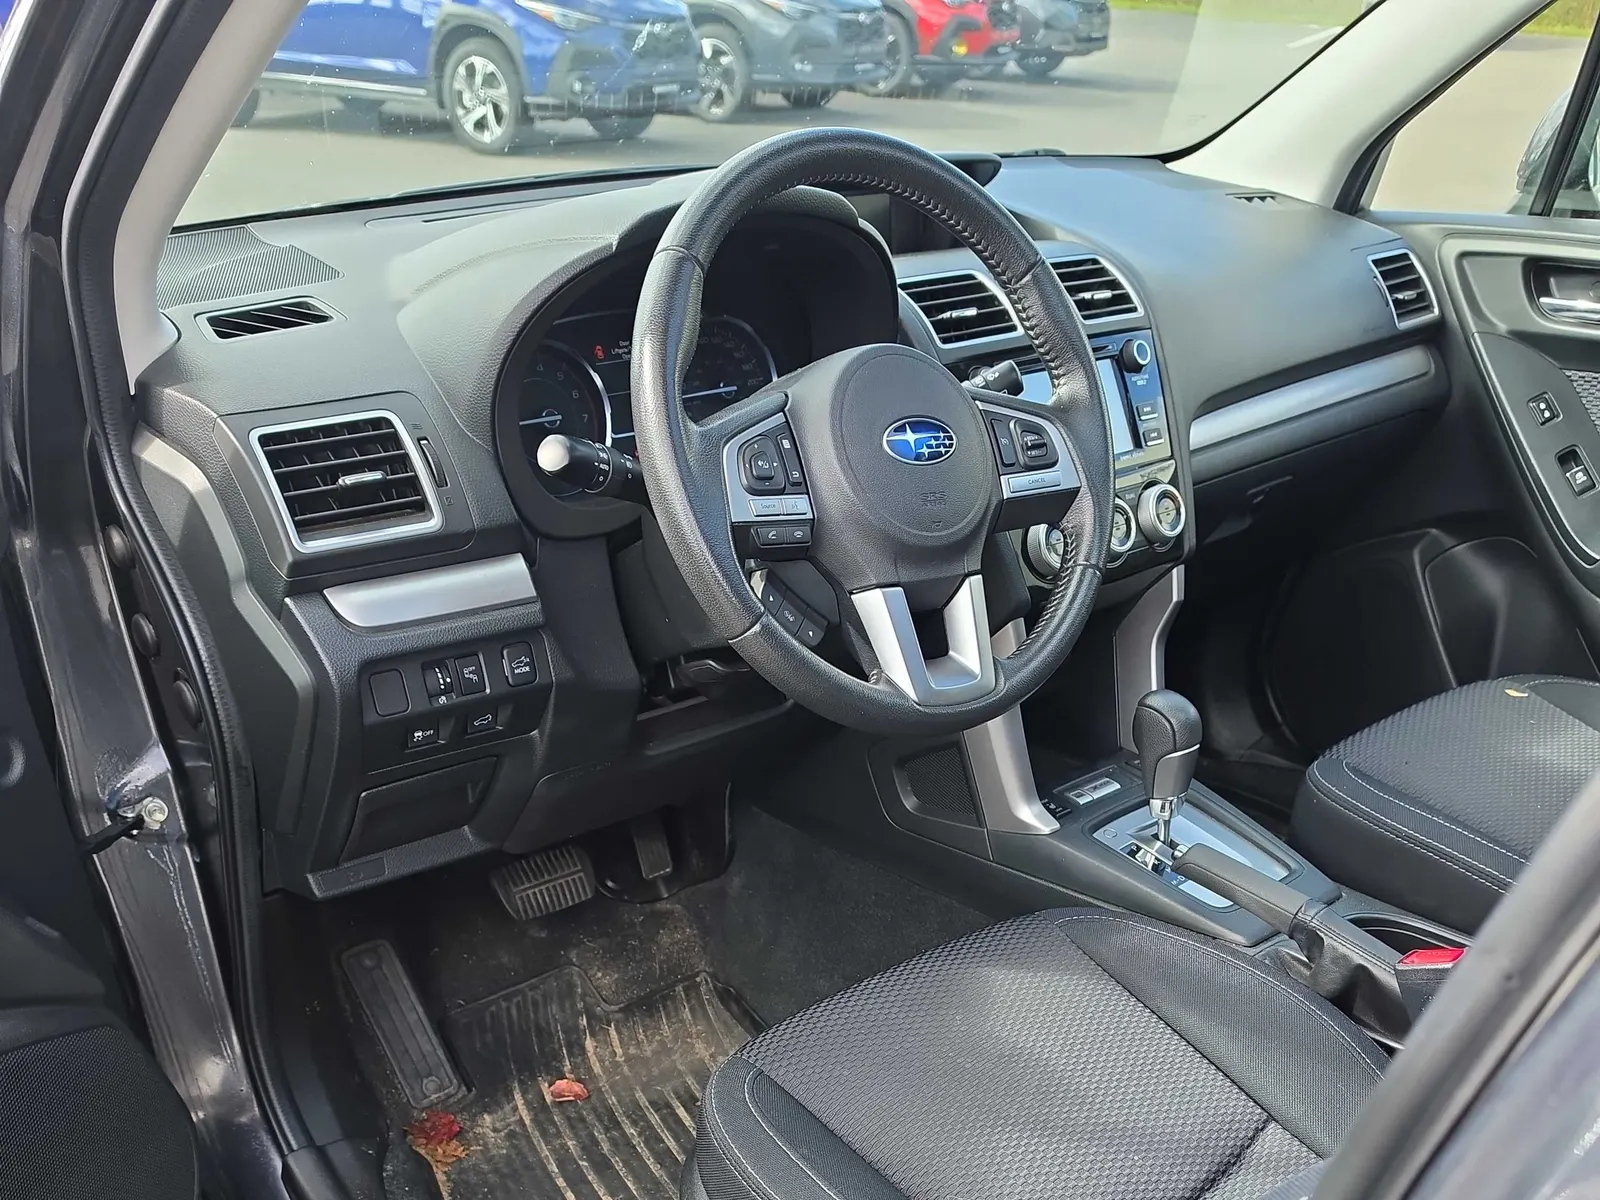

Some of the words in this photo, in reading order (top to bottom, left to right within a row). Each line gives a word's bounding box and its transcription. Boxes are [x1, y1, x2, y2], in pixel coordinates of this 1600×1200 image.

[572, 389, 580, 399] 6
[582, 414, 589, 423] 7
[920, 491, 948, 500] SRS
[514, 665, 531, 675] MODE
[422, 729, 434, 738] OFF
